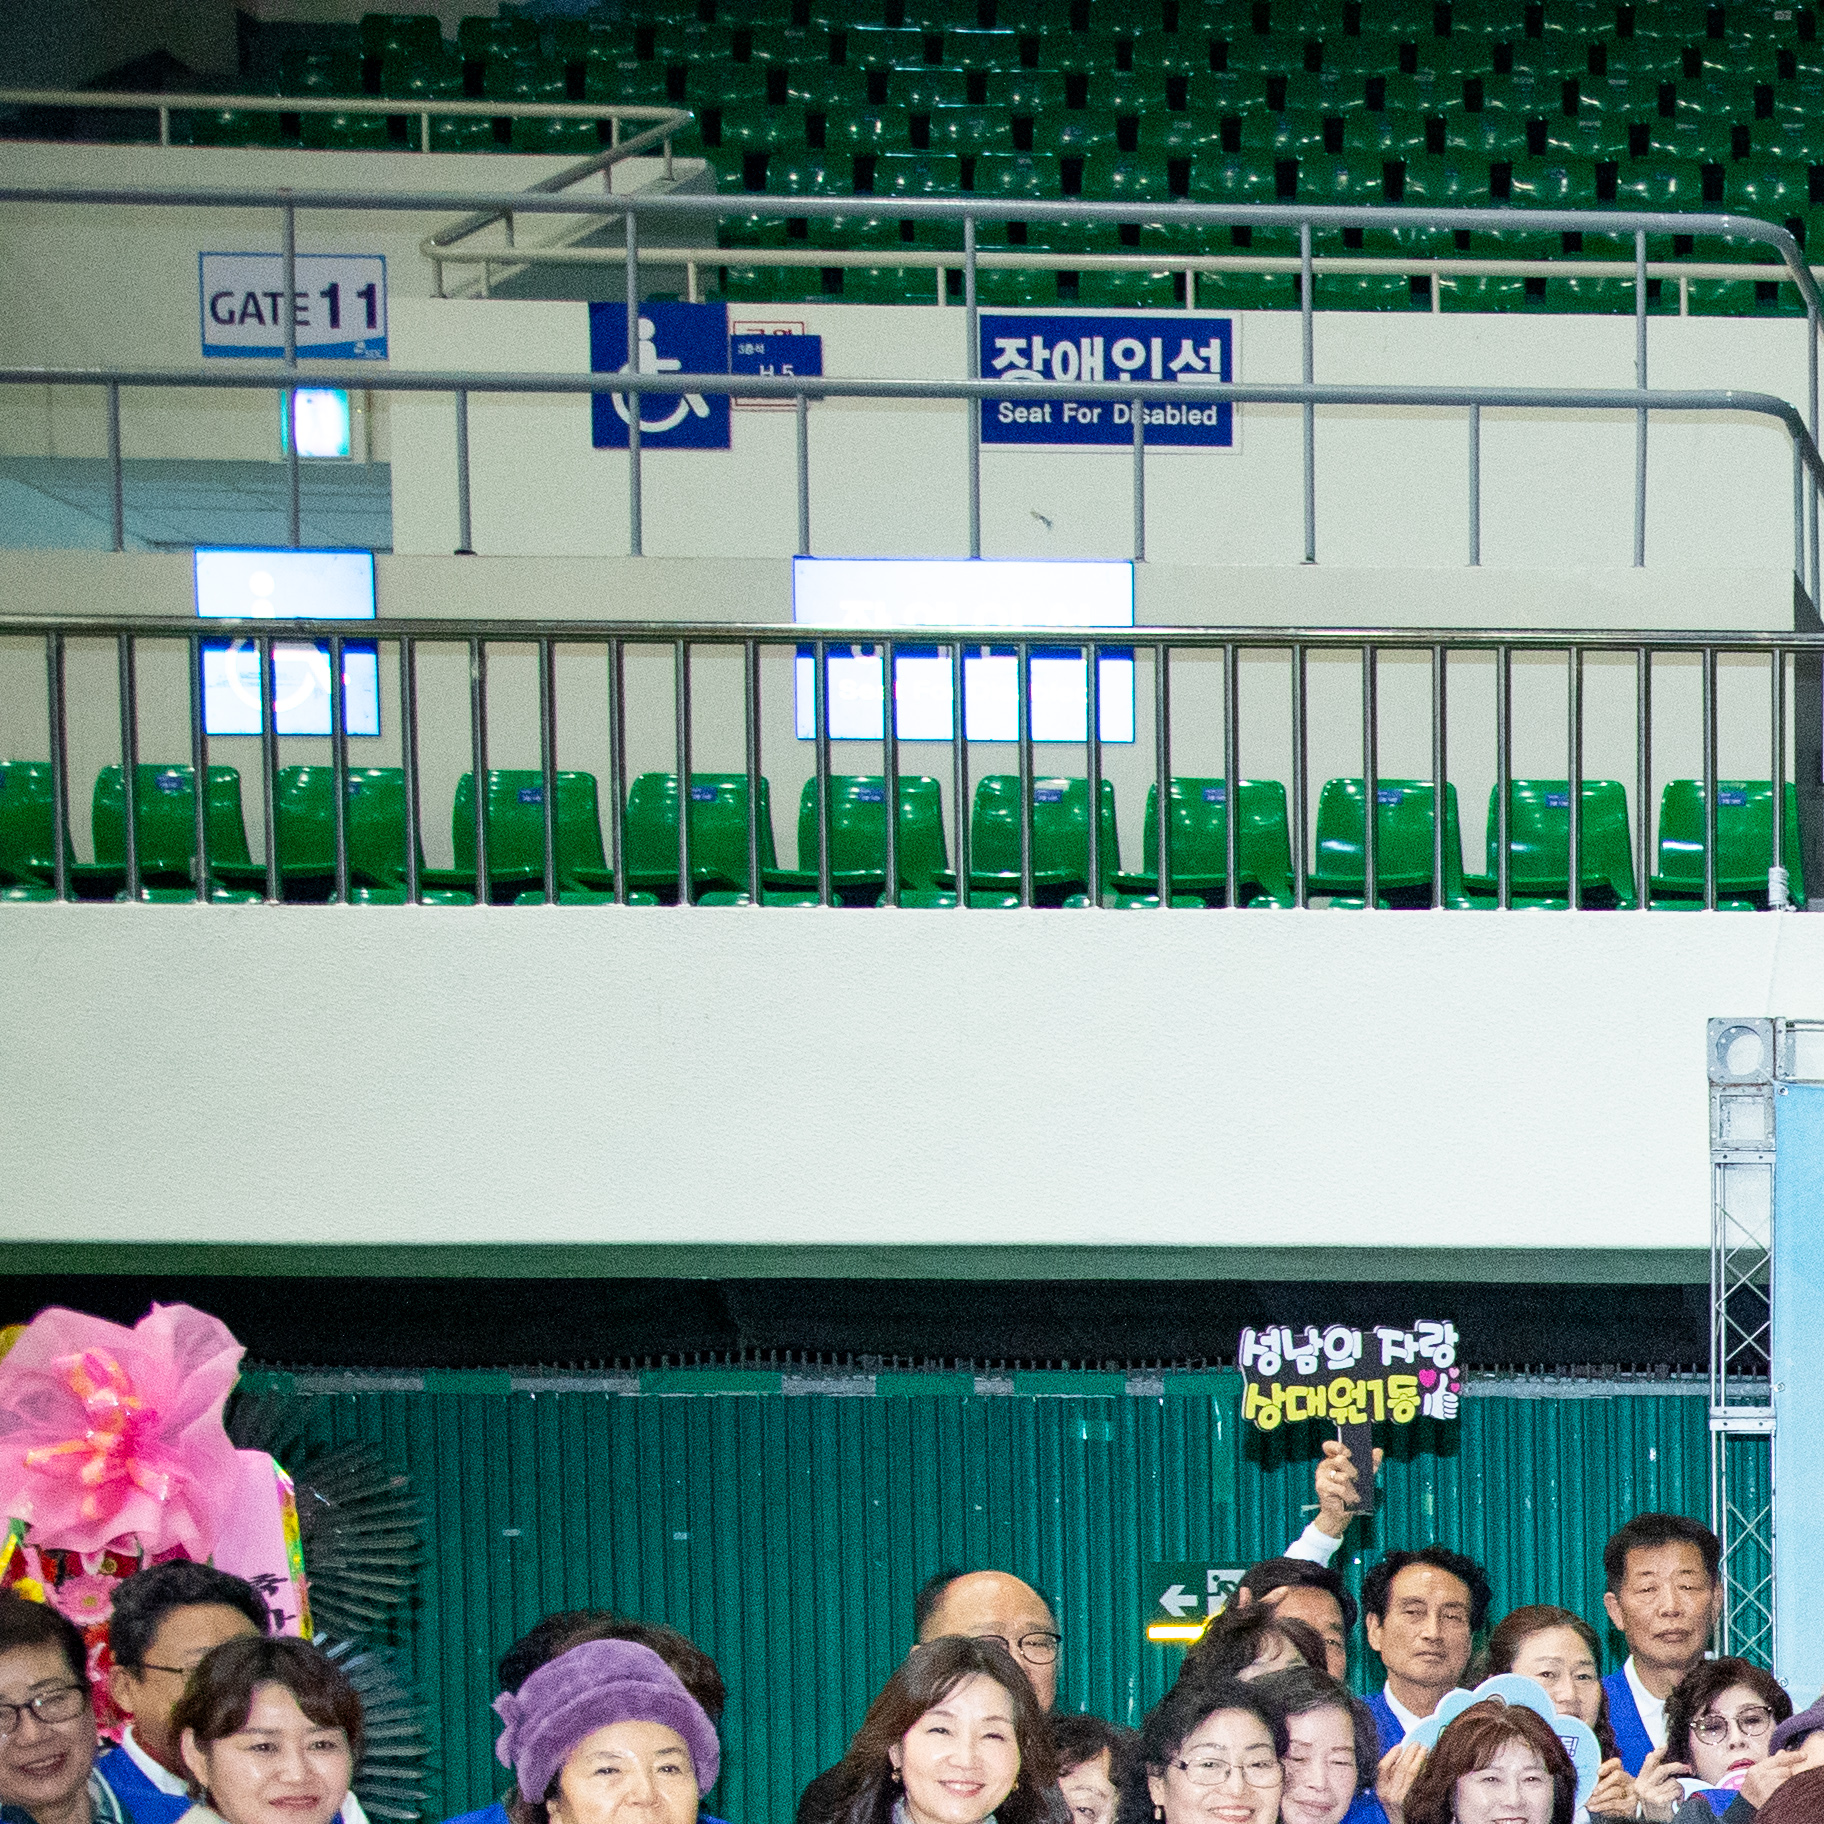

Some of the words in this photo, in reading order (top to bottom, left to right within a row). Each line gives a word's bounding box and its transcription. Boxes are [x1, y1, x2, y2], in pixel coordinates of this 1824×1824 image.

[210, 290, 310, 326] GATE
[320, 282, 377, 329] 11
[991, 335, 1222, 383] 장애인석
[998, 402, 1051, 423] Seat
[1062, 403, 1102, 424] For
[1113, 403, 1218, 426] Disabled
[1241, 1326, 1363, 1377] 성남의
[1374, 1319, 1460, 1369] 자랑
[1244, 1374, 1422, 1431] 상대원1동
